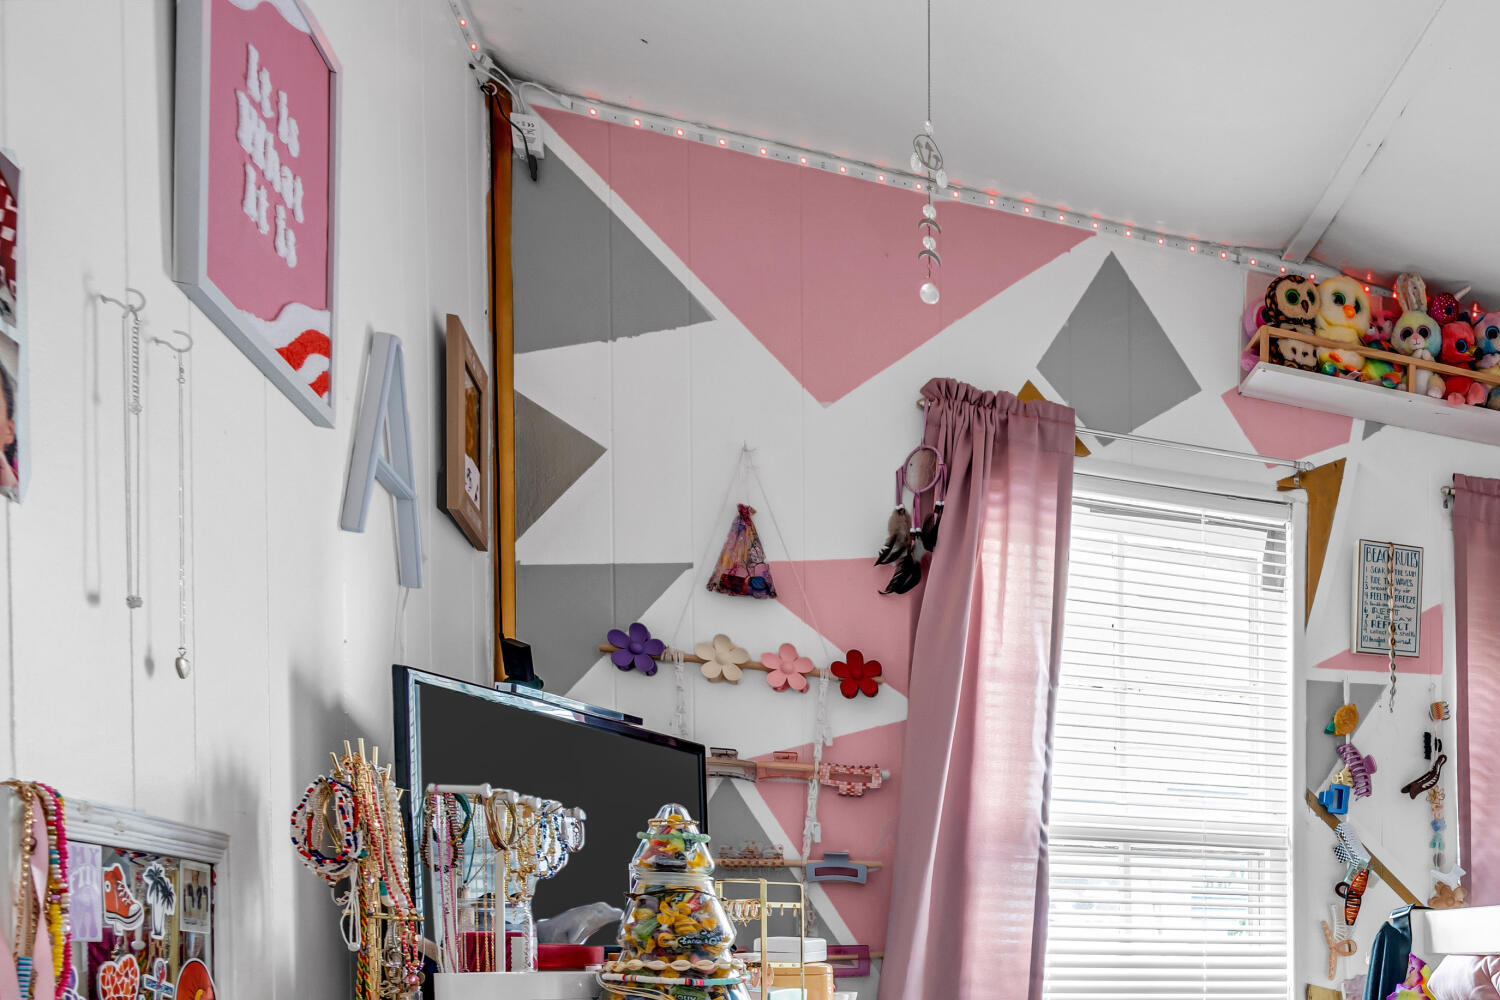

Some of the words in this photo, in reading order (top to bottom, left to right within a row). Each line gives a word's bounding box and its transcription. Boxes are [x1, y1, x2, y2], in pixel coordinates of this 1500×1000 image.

[246, 43, 273, 118] It
[242, 161, 271, 236] It
[1366, 546, 1390, 564] BEAC
[1395, 552, 1418, 568] RULES
[1394, 594, 1417, 604] BREEZE
